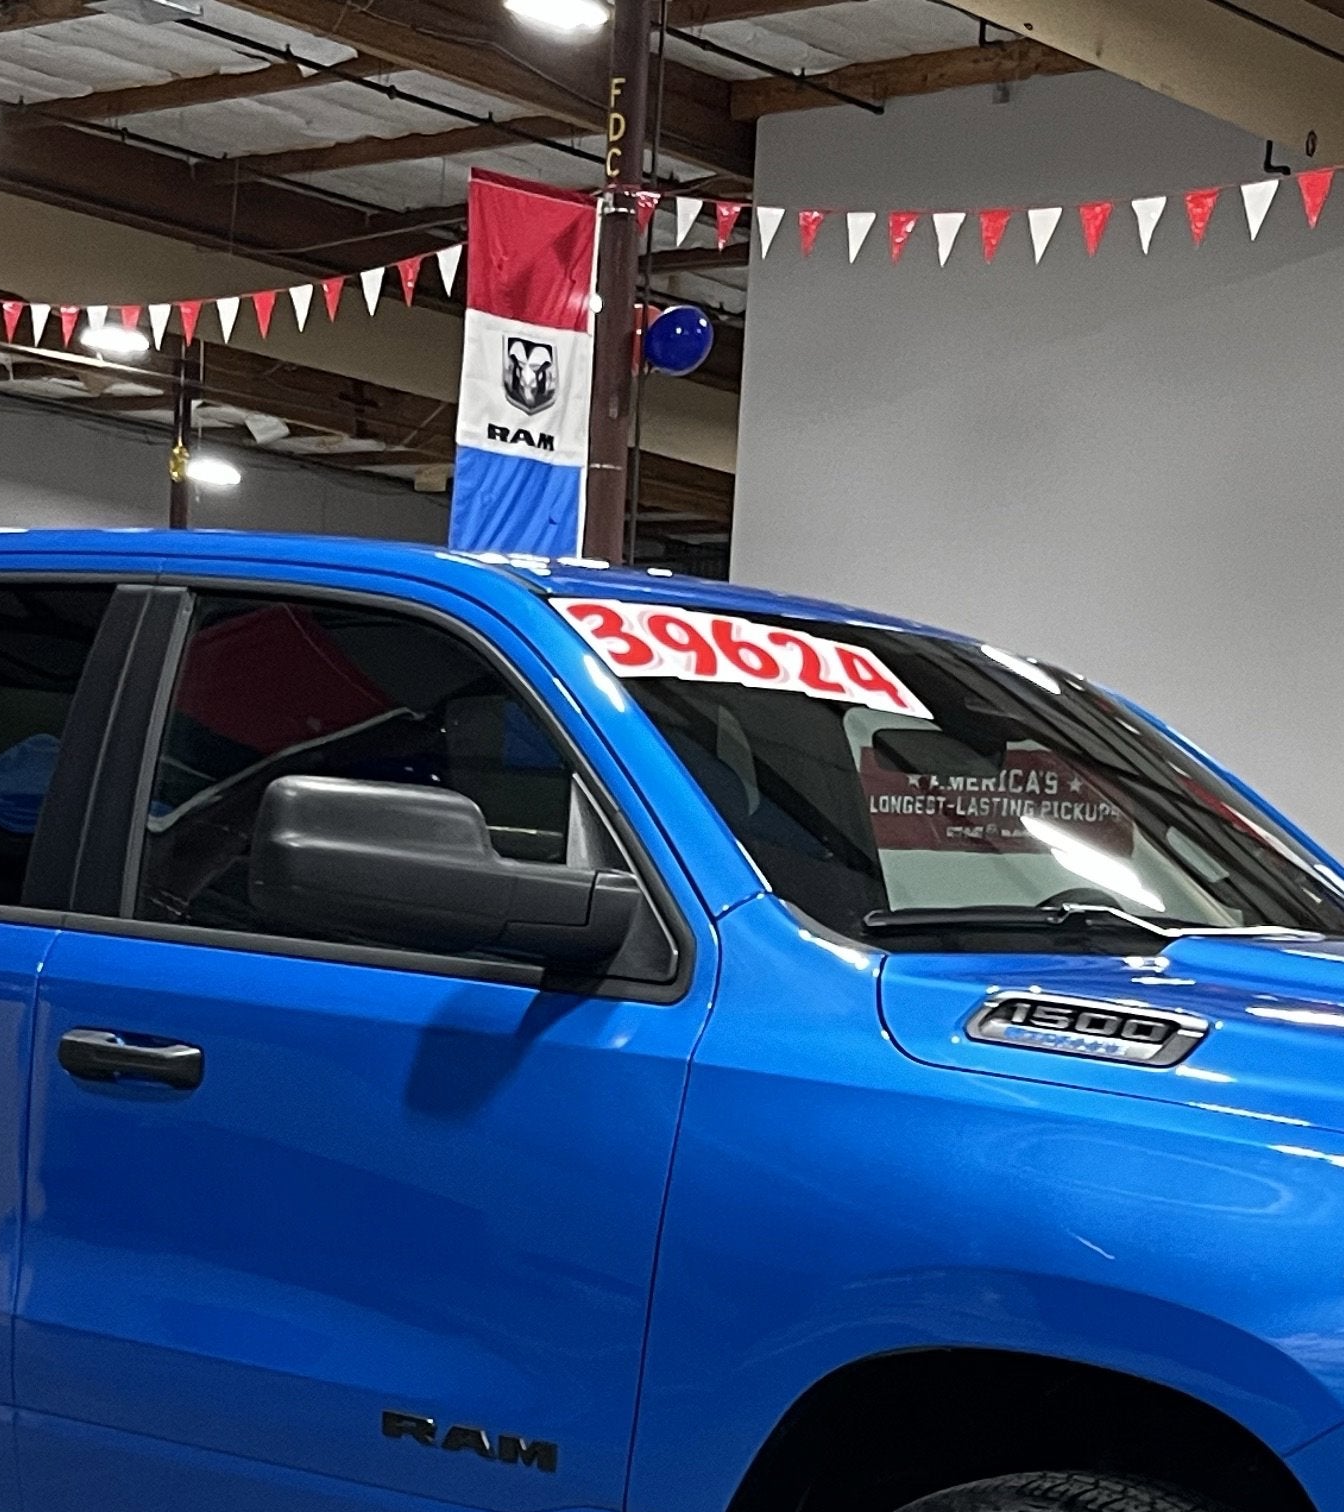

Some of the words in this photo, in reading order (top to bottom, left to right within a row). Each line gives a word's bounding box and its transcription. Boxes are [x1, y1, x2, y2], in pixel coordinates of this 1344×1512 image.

[487, 423, 555, 452] RAM
[566, 603, 908, 709] 39624
[869, 795, 1034, 818] LONGEST-LASTING
[1010, 1002, 1170, 1042] 1500
[381, 1410, 557, 1473] RAM
